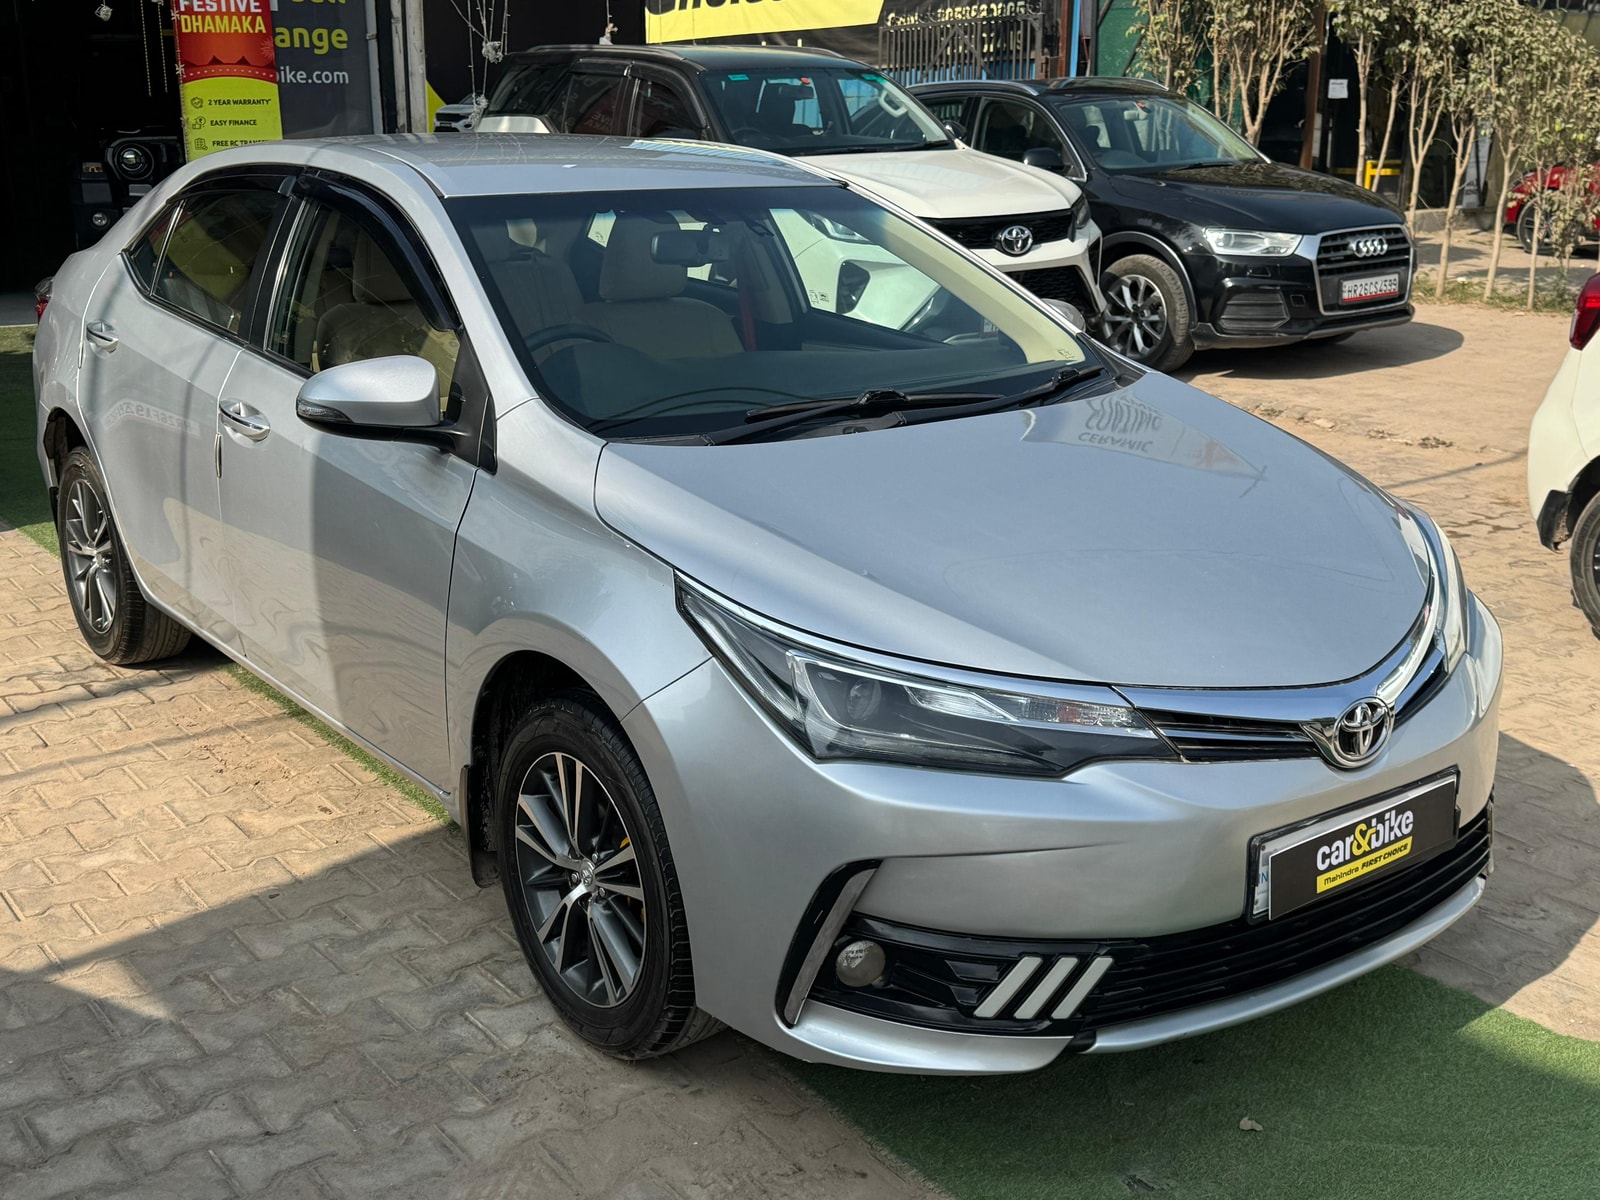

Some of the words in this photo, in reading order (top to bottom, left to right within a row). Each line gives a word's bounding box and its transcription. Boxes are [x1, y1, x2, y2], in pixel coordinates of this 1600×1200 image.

[179, 0, 262, 13] FESTIVE
[181, 15, 266, 34] DHAMAKA
[276, 65, 349, 84] ike.com
[229, 119, 257, 127] FINANCE
[1316, 809, 1414, 871] car&bike
[1324, 866, 1360, 886] Mahindra
[1361, 855, 1382, 870] FIRST
[1383, 842, 1409, 860] CHOICE
